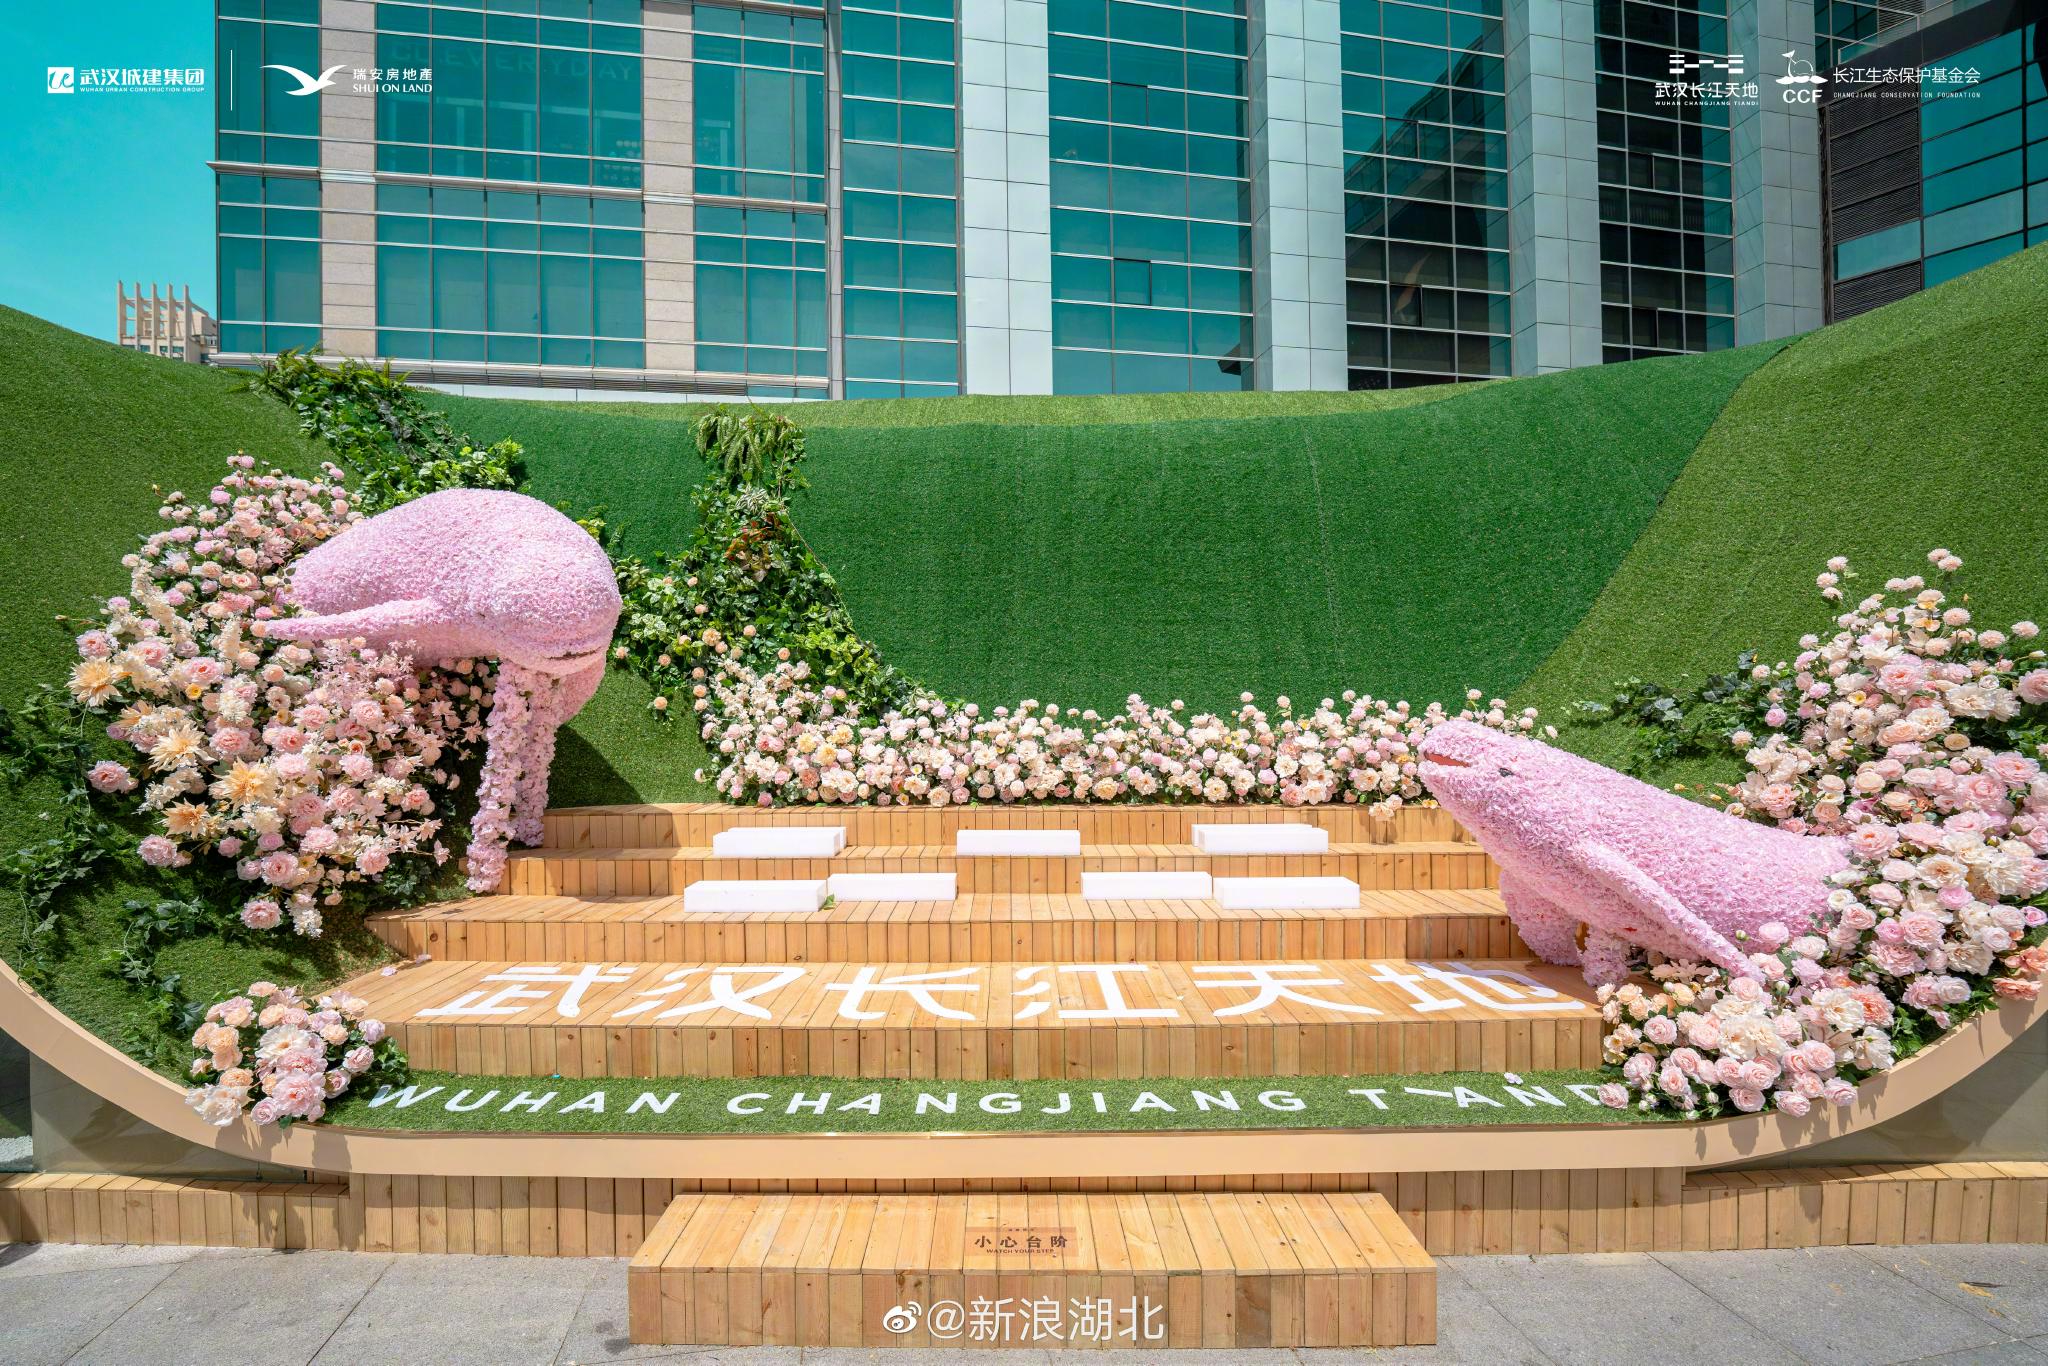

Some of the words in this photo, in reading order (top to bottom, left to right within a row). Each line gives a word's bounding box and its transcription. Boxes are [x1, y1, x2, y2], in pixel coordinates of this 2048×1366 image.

[416, 963, 1585, 1020] 武汉长江天地
[367, 1085, 681, 1114] WUHAN
[726, 1090, 1307, 1116] CHANGJIANG
[974, 1235, 1068, 1248] 小心台阶
